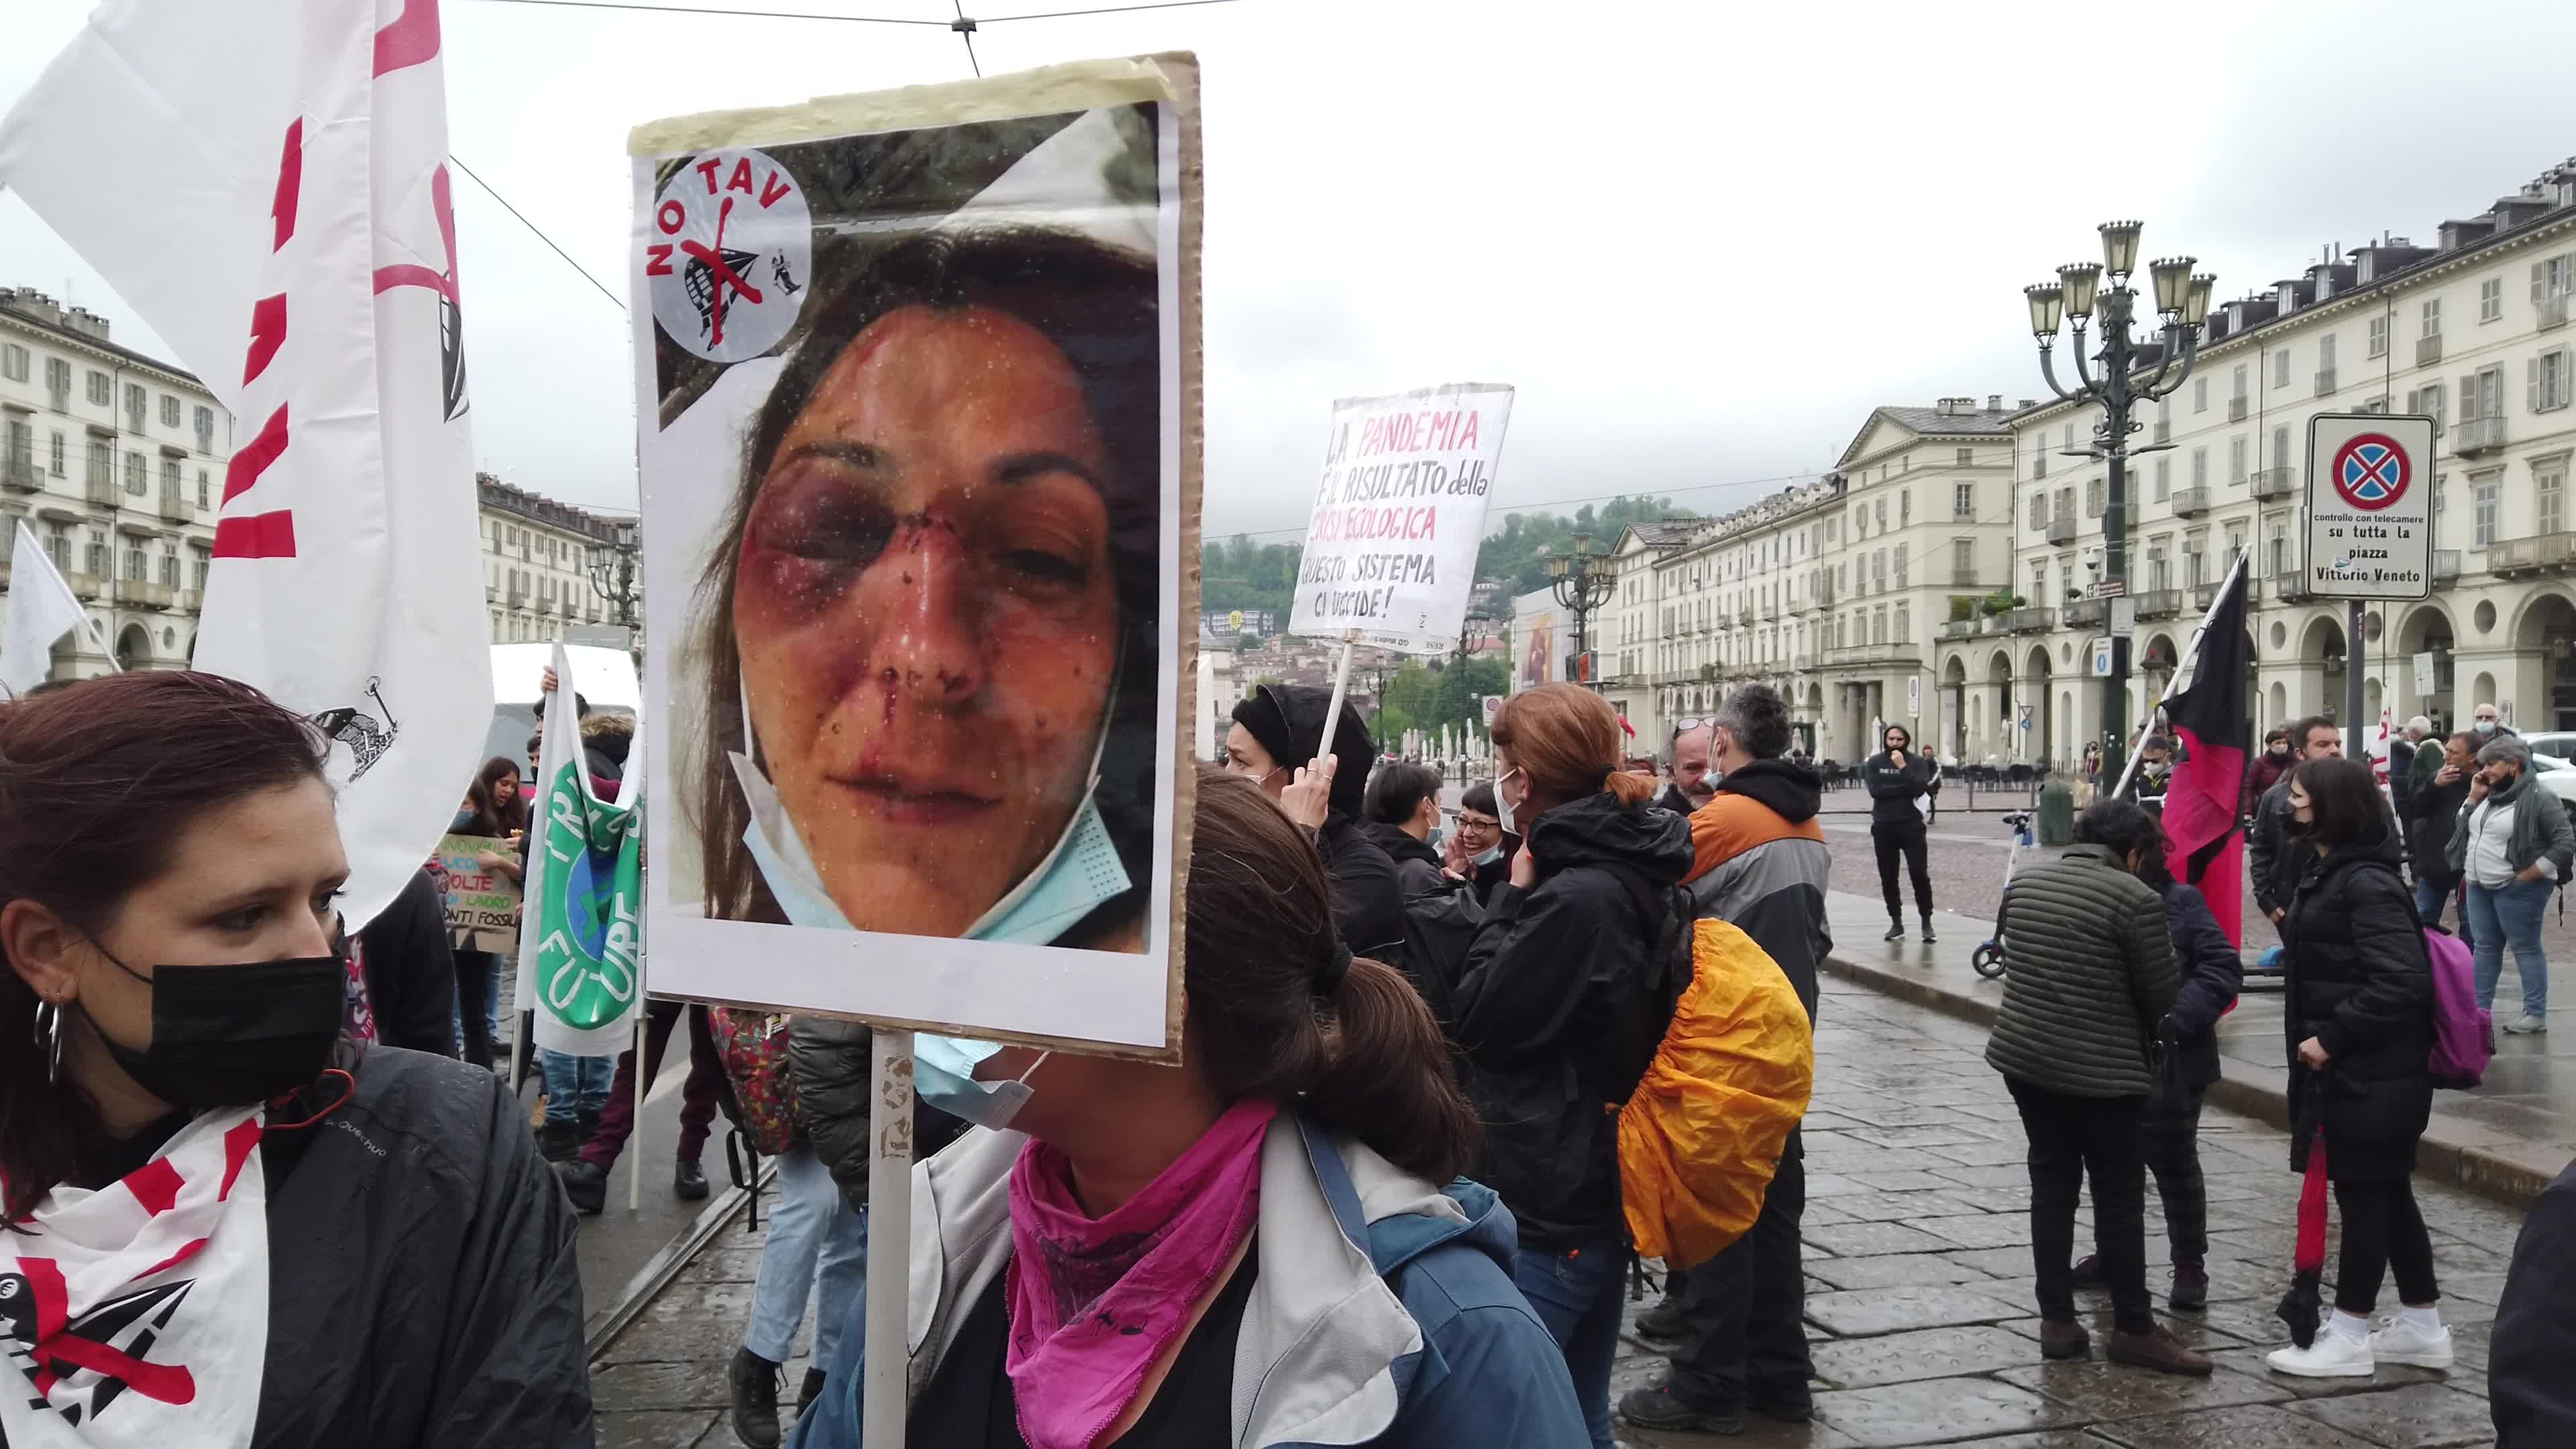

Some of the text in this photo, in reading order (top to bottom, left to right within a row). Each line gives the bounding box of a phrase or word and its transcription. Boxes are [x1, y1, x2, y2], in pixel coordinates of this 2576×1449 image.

[646, 157, 791, 276] NO TAV
[1326, 410, 1479, 464] LA PANDEMIA
[1343, 460, 1446, 504] RISULTATO
[1448, 459, 1488, 496] della
[1343, 505, 1436, 541] ECOLOGICA
[2314, 513, 2353, 523] controllo
[2374, 515, 2424, 523] telecamere
[2329, 526, 2410, 538] su tutta la
[2349, 545, 2388, 560] piazza
[1301, 553, 1436, 585] QUESTO SISTEMA
[2375, 568, 2420, 582] Veneto
[1314, 591, 1326, 618] CI
[450, 873, 494, 892] OLTE
